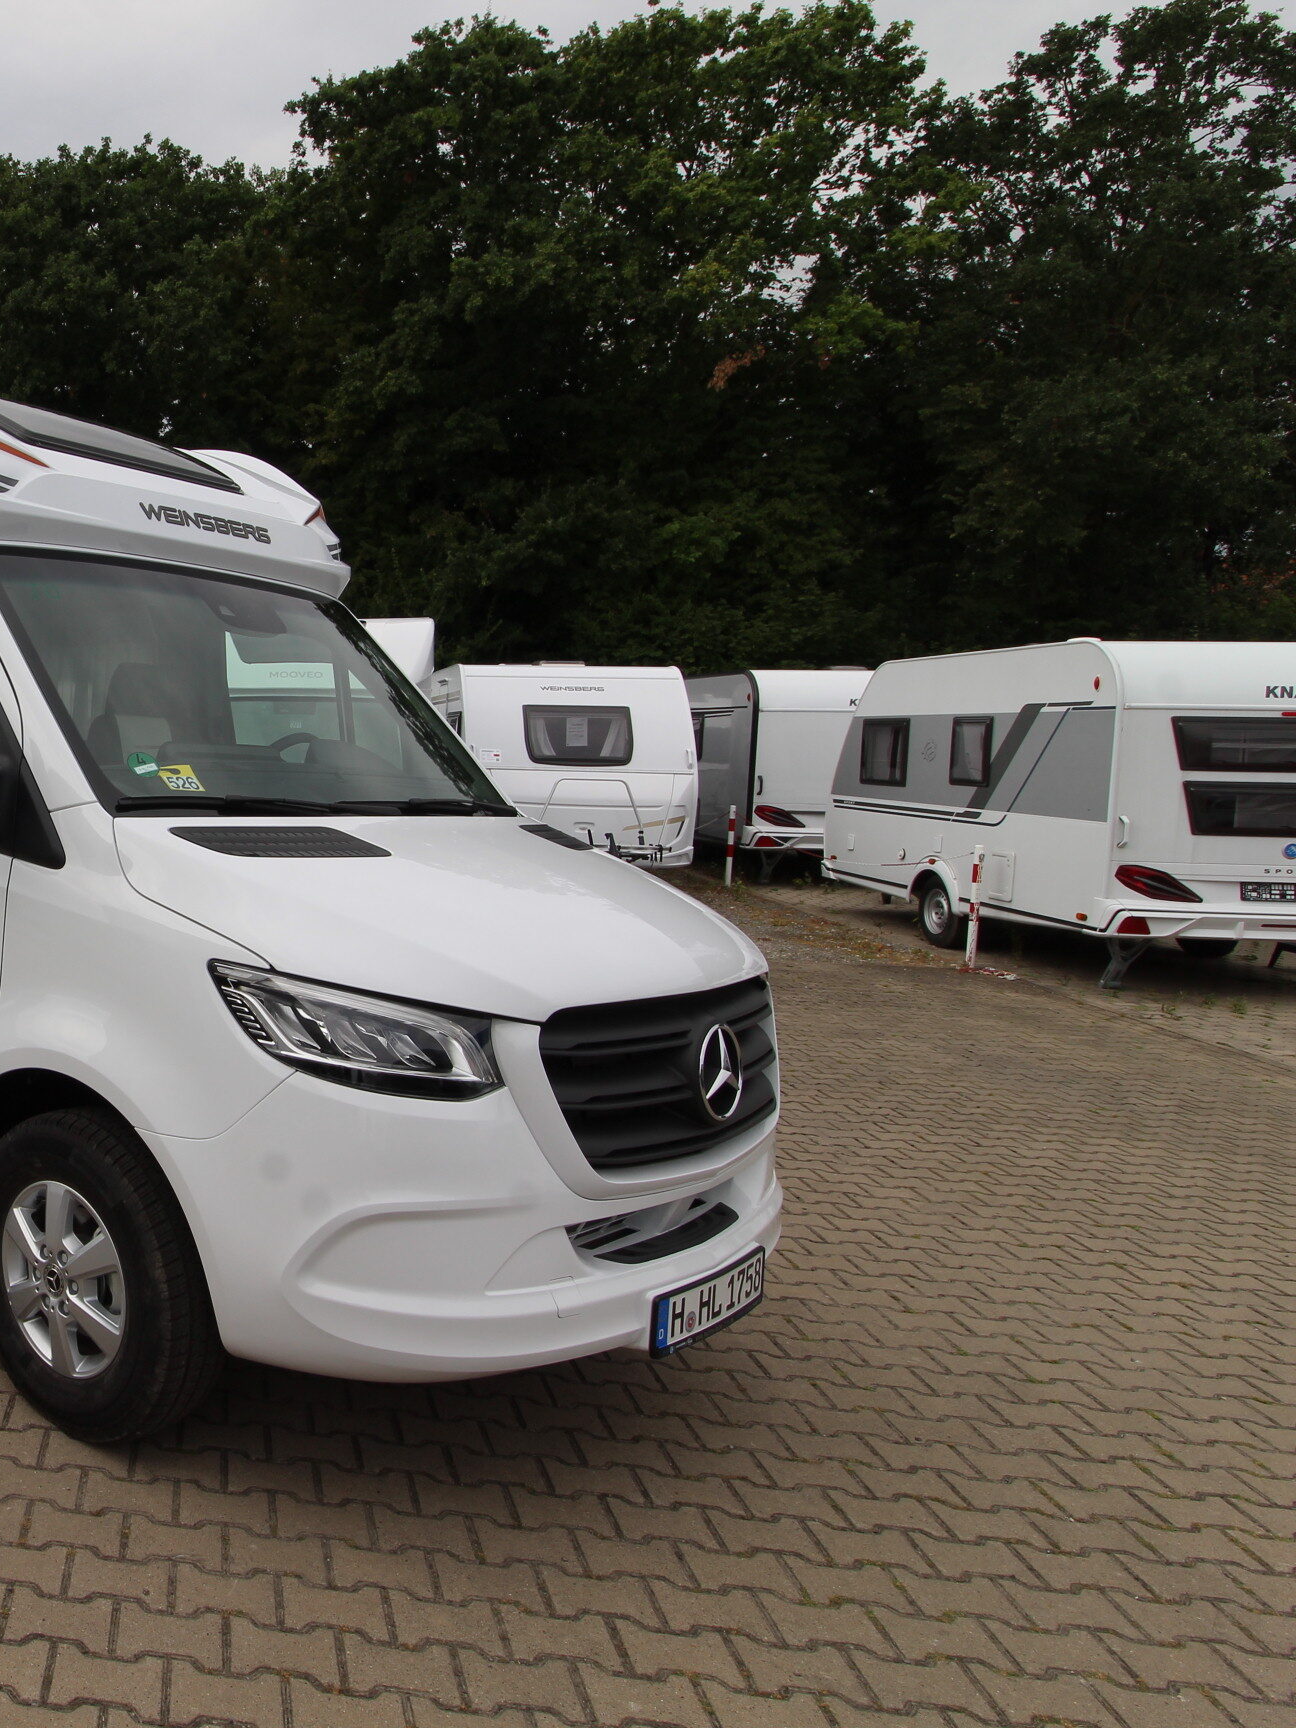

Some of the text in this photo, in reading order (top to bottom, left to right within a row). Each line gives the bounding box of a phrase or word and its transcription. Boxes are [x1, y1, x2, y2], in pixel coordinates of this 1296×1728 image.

[139, 501, 271, 544] WEINSBERG
[269, 671, 324, 679] MOOVEO
[1265, 685, 1296, 698] KN
[166, 776, 200, 790] 526
[670, 1257, 762, 1338] H HL 1758
[658, 1329, 664, 1339] D
